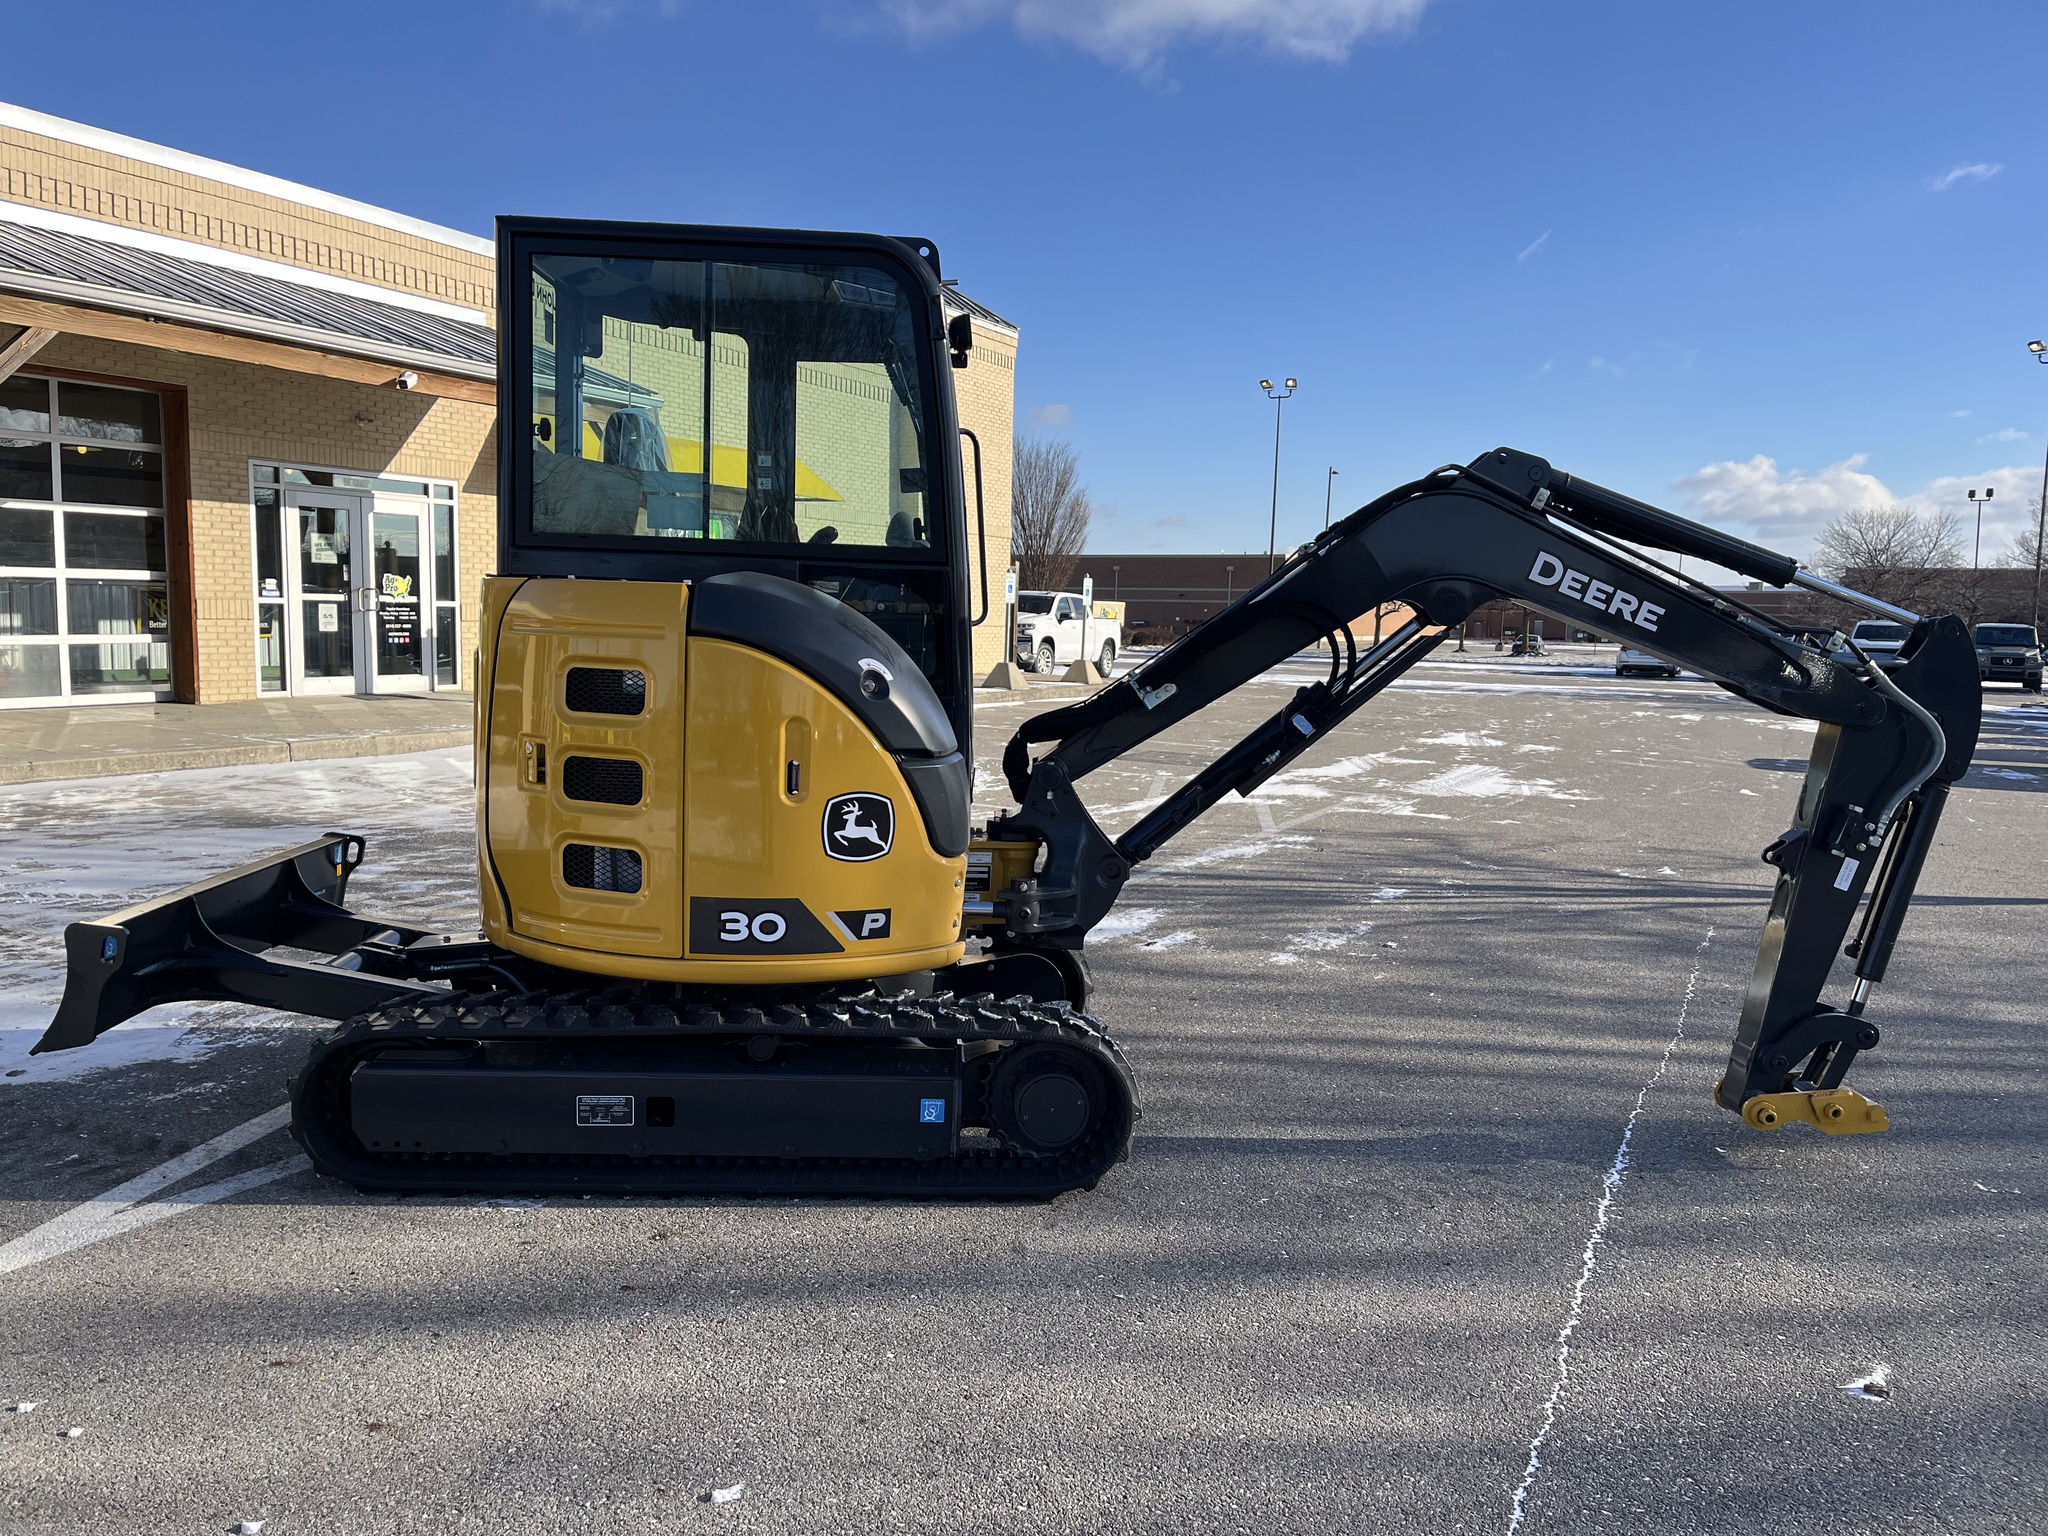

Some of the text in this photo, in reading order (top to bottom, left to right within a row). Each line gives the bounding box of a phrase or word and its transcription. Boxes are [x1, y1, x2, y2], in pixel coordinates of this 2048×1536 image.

[384, 584, 398, 592] Pro
[1528, 551, 1666, 632] DEERE
[149, 620, 168, 629] Better
[720, 911, 787, 942] 30
[861, 913, 886, 937] P
